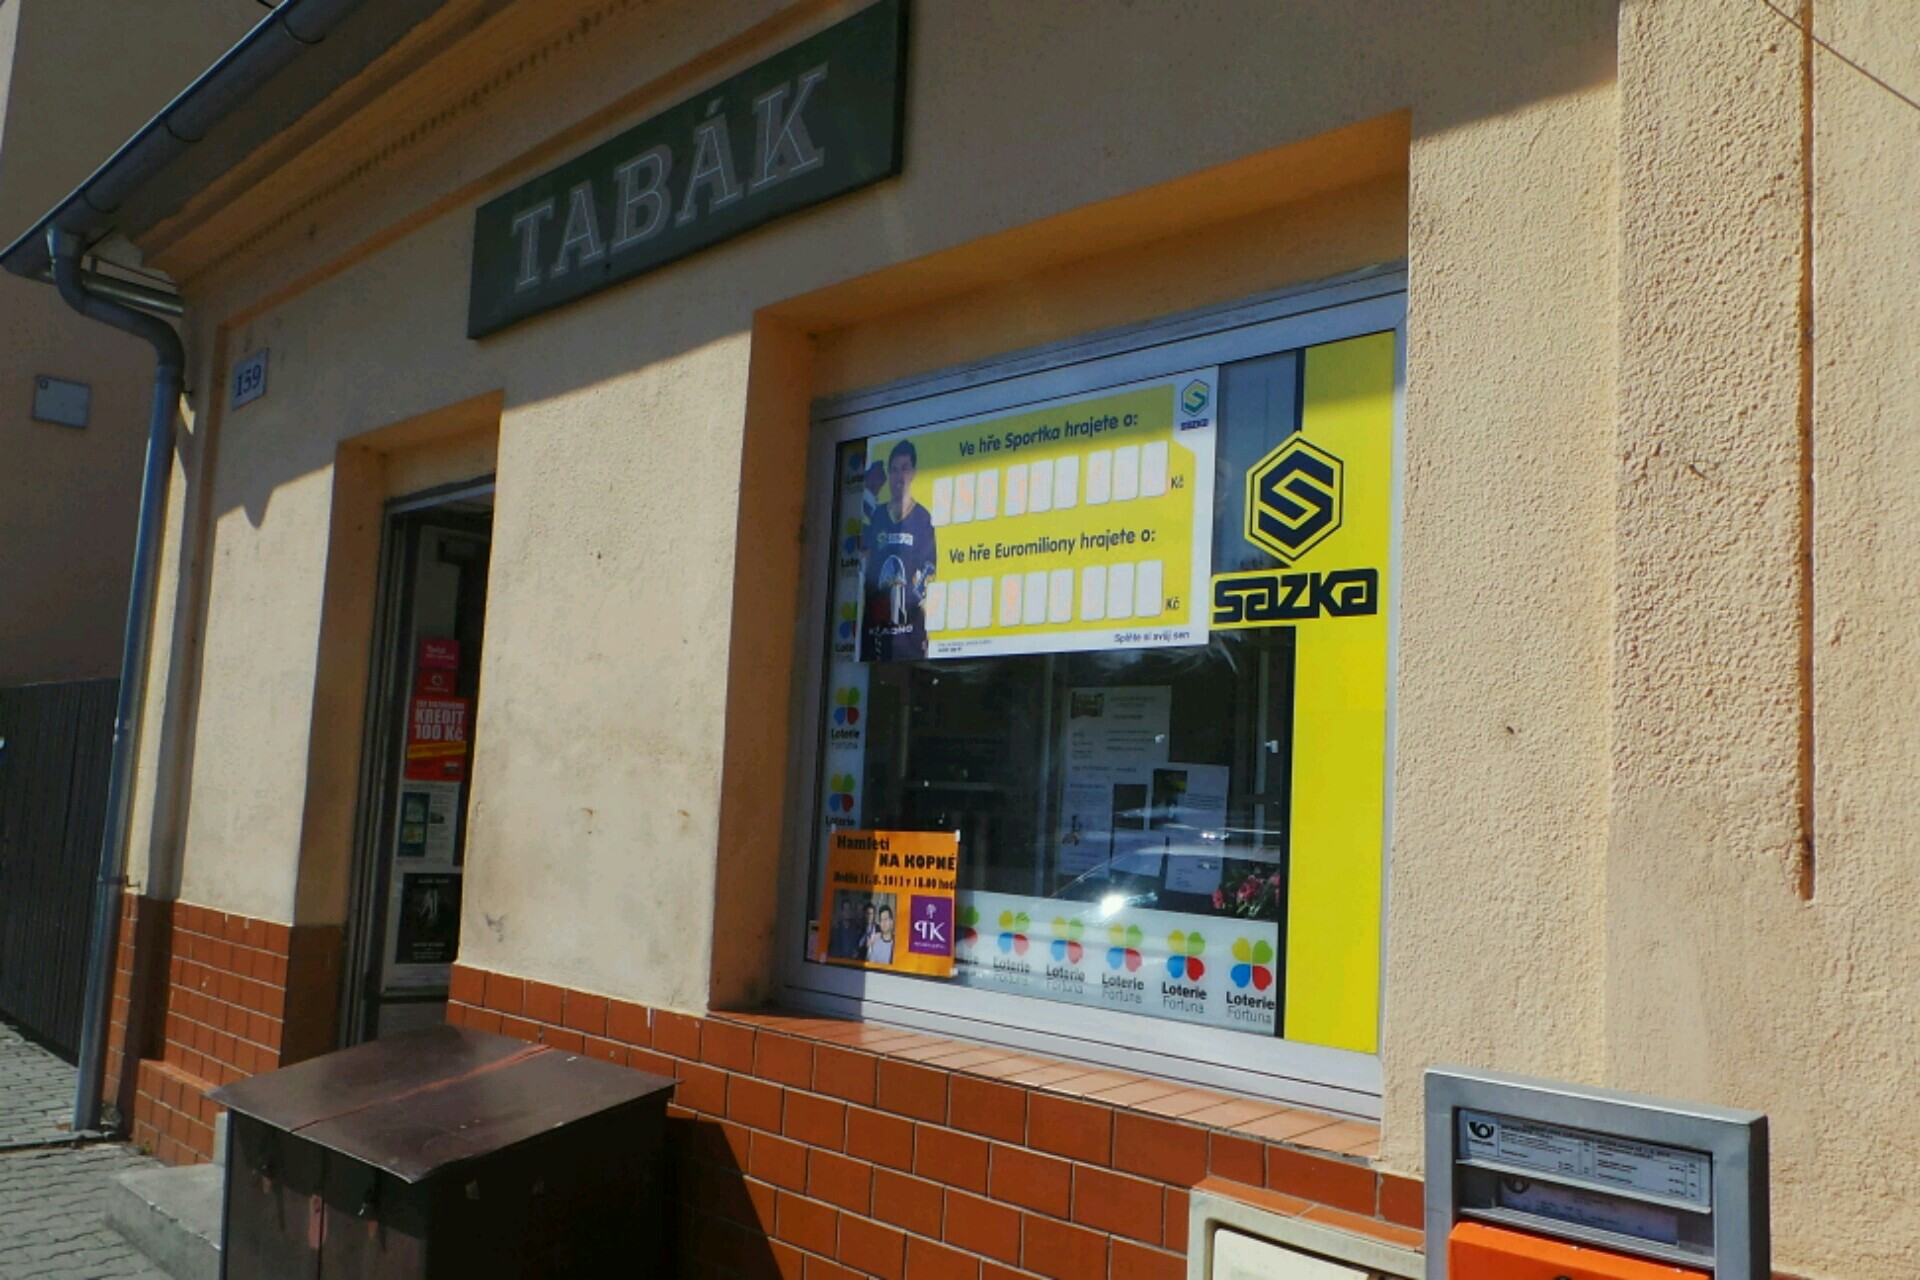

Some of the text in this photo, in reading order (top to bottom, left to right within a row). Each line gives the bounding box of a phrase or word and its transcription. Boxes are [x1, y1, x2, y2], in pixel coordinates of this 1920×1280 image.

[510, 61, 829, 294] TABÁK
[236, 364, 261, 397] 159
[959, 414, 1139, 457] Ve hře Sportka hrajete o:
[949, 528, 1156, 564] Ve hře Euromiliony hrajete o:
[415, 709, 465, 725] KREDIT
[414, 724, 441, 740] 100
[837, 836, 890, 851] Hamleti
[879, 853, 899, 868] NA
[1046, 964, 1085, 982] Loterie
[1102, 973, 1144, 990] Loterie
[1162, 982, 1207, 1000] Loterie
[1163, 996, 1205, 1014] Fortuna
[1226, 991, 1276, 1010] Loterie
[1227, 1006, 1272, 1024] Fortuna
